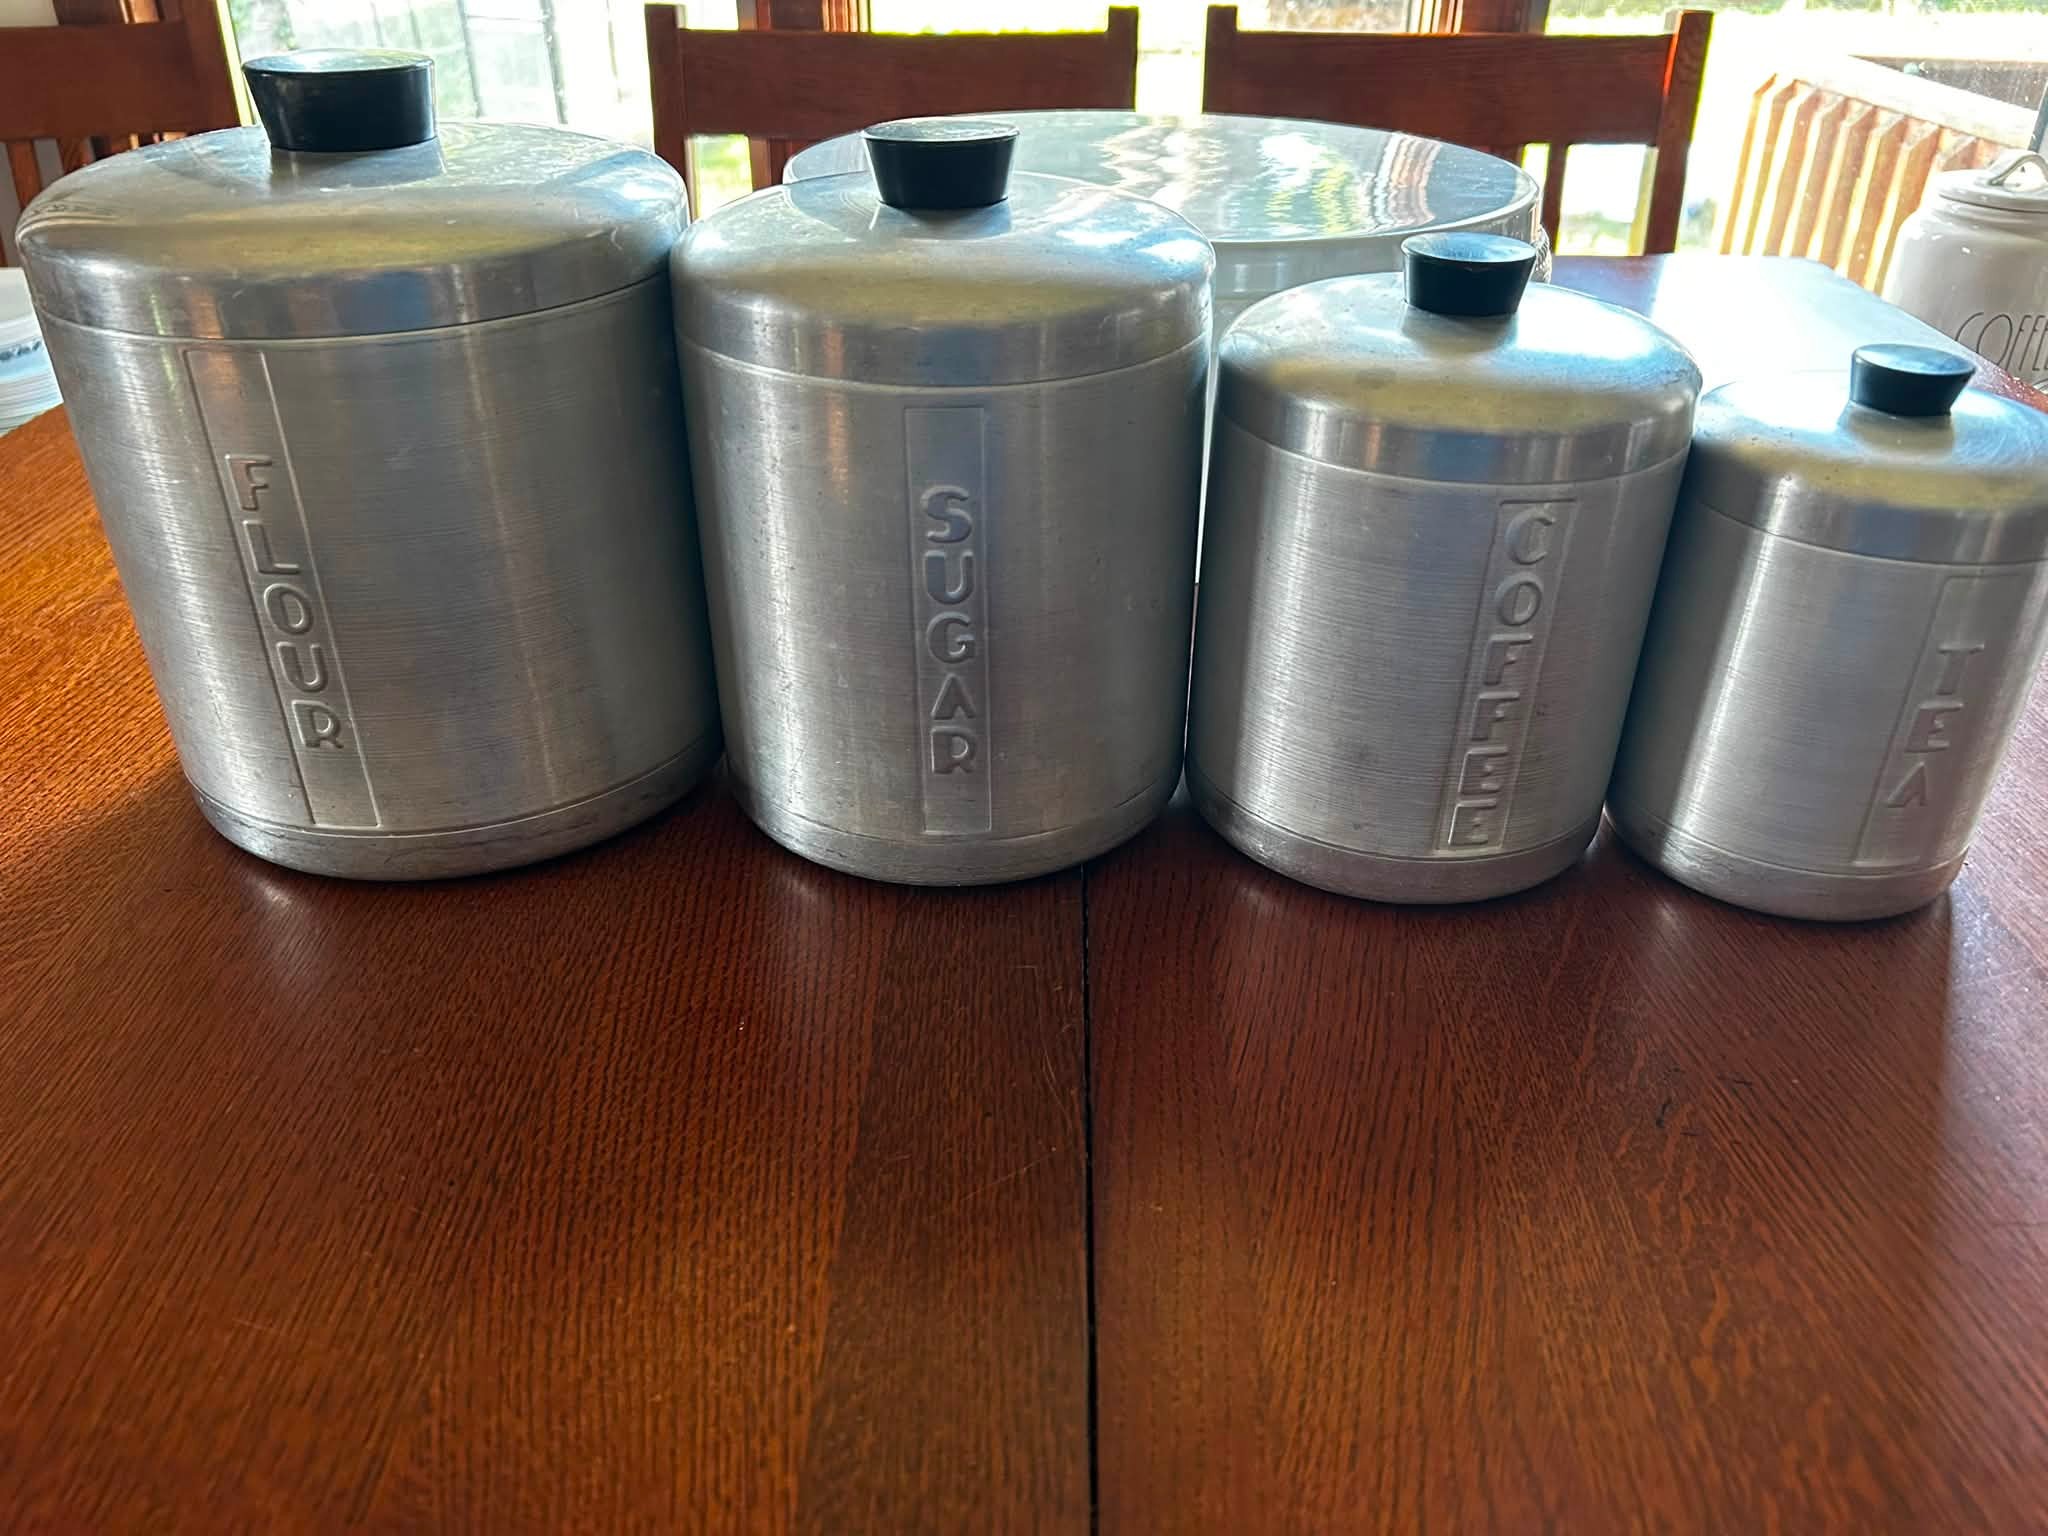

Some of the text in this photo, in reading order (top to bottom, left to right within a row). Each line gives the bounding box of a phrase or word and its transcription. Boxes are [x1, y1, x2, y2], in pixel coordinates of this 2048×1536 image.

[1954, 311, 2048, 371] COFFE
[225, 453, 344, 749] FLOUR
[920, 484, 977, 775] SUGAR
[1447, 508, 1557, 845] COFFEE
[1886, 642, 1985, 809] TEA
